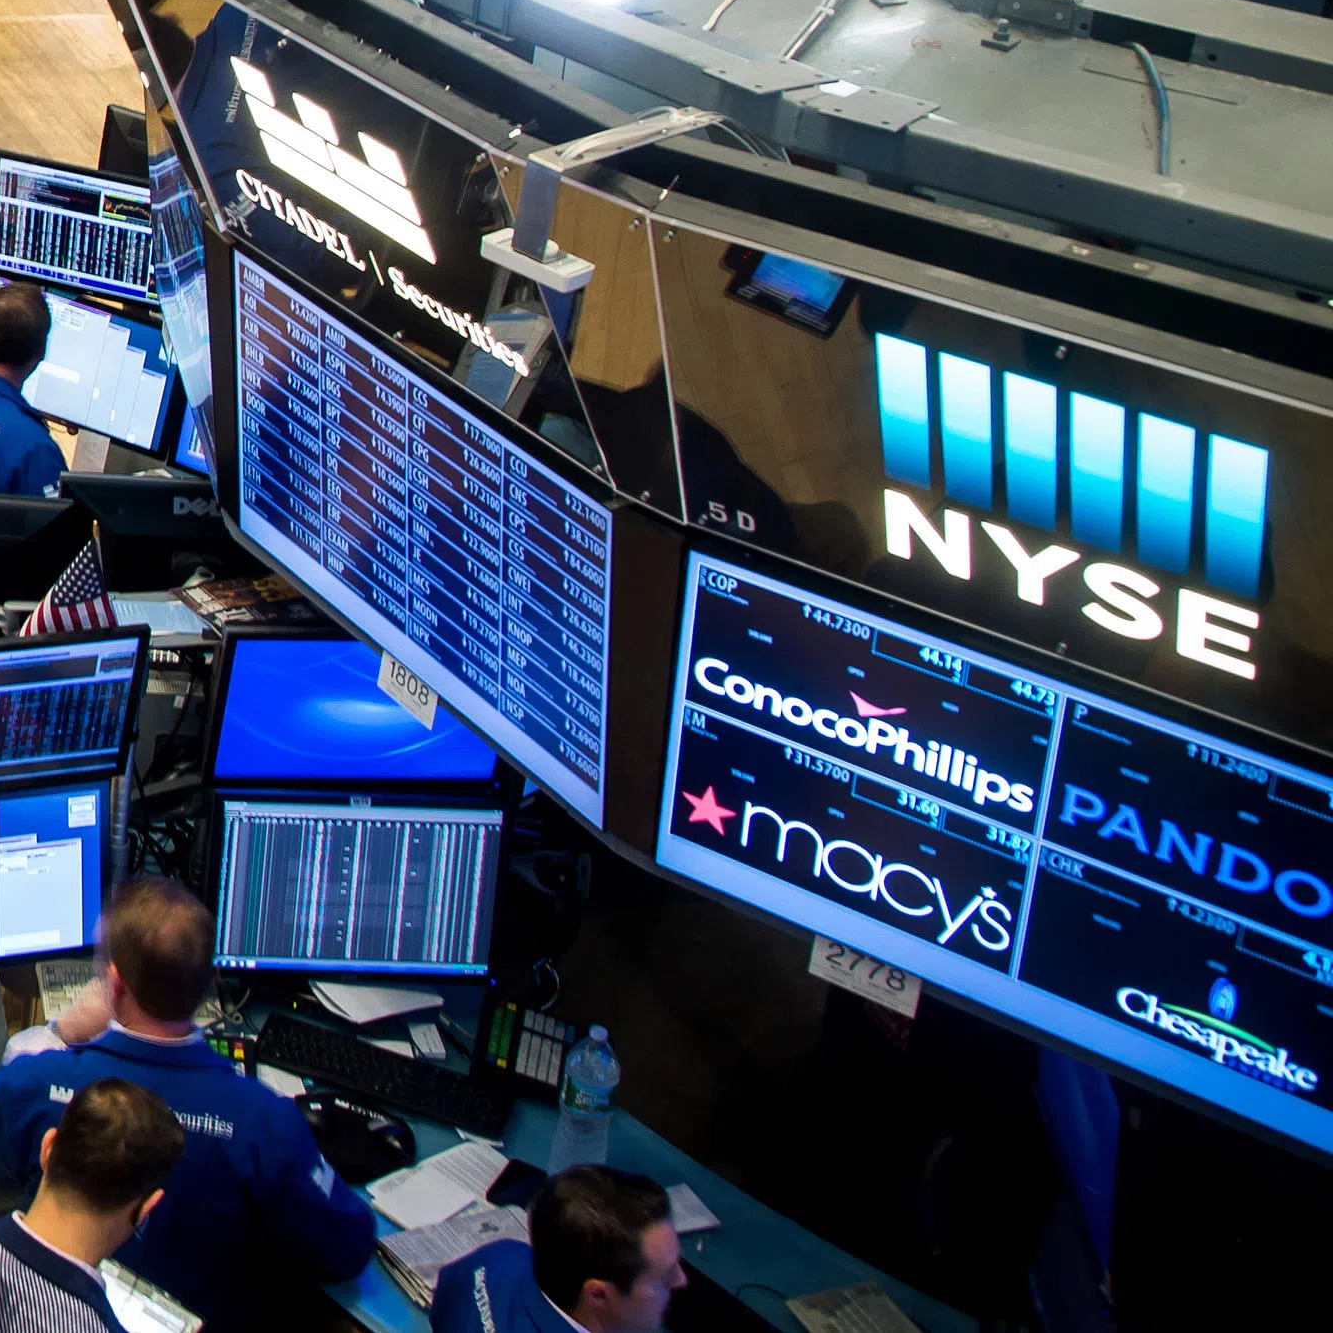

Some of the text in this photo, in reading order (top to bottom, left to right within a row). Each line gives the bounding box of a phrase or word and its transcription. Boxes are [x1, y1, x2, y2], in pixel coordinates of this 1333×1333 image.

[235, 168, 367, 272] CITADEL
[387, 265, 531, 377] Securities
[412, 387, 428, 408] CCS
[412, 415, 426, 434] CFI
[412, 441, 429, 463] CPG
[509, 456, 528, 478] CCU
[412, 469, 429, 490] CSH
[412, 494, 428, 514] CSV
[509, 484, 528, 507] CNS
[509, 512, 526, 534] CPS
[508, 539, 525, 561] CSS
[707, 570, 737, 594] COP
[883, 487, 1261, 681] NYSE
[508, 592, 523, 615] INT
[507, 620, 533, 647] KNOP
[812, 606, 870, 641] 44.7300
[918, 646, 963, 673] 44.14
[388, 659, 431, 708] 1808
[507, 672, 526, 698] NOA
[691, 713, 706, 730] M
[1073, 703, 1088, 720] P
[694, 656, 1034, 813] ConocoPhillips
[793, 748, 1031, 853] 31.5700 31.60 31.87
[1049, 852, 1085, 880] CHK
[825, 941, 907, 993] 2778
[1116, 985, 1319, 1093] Chesapeake
